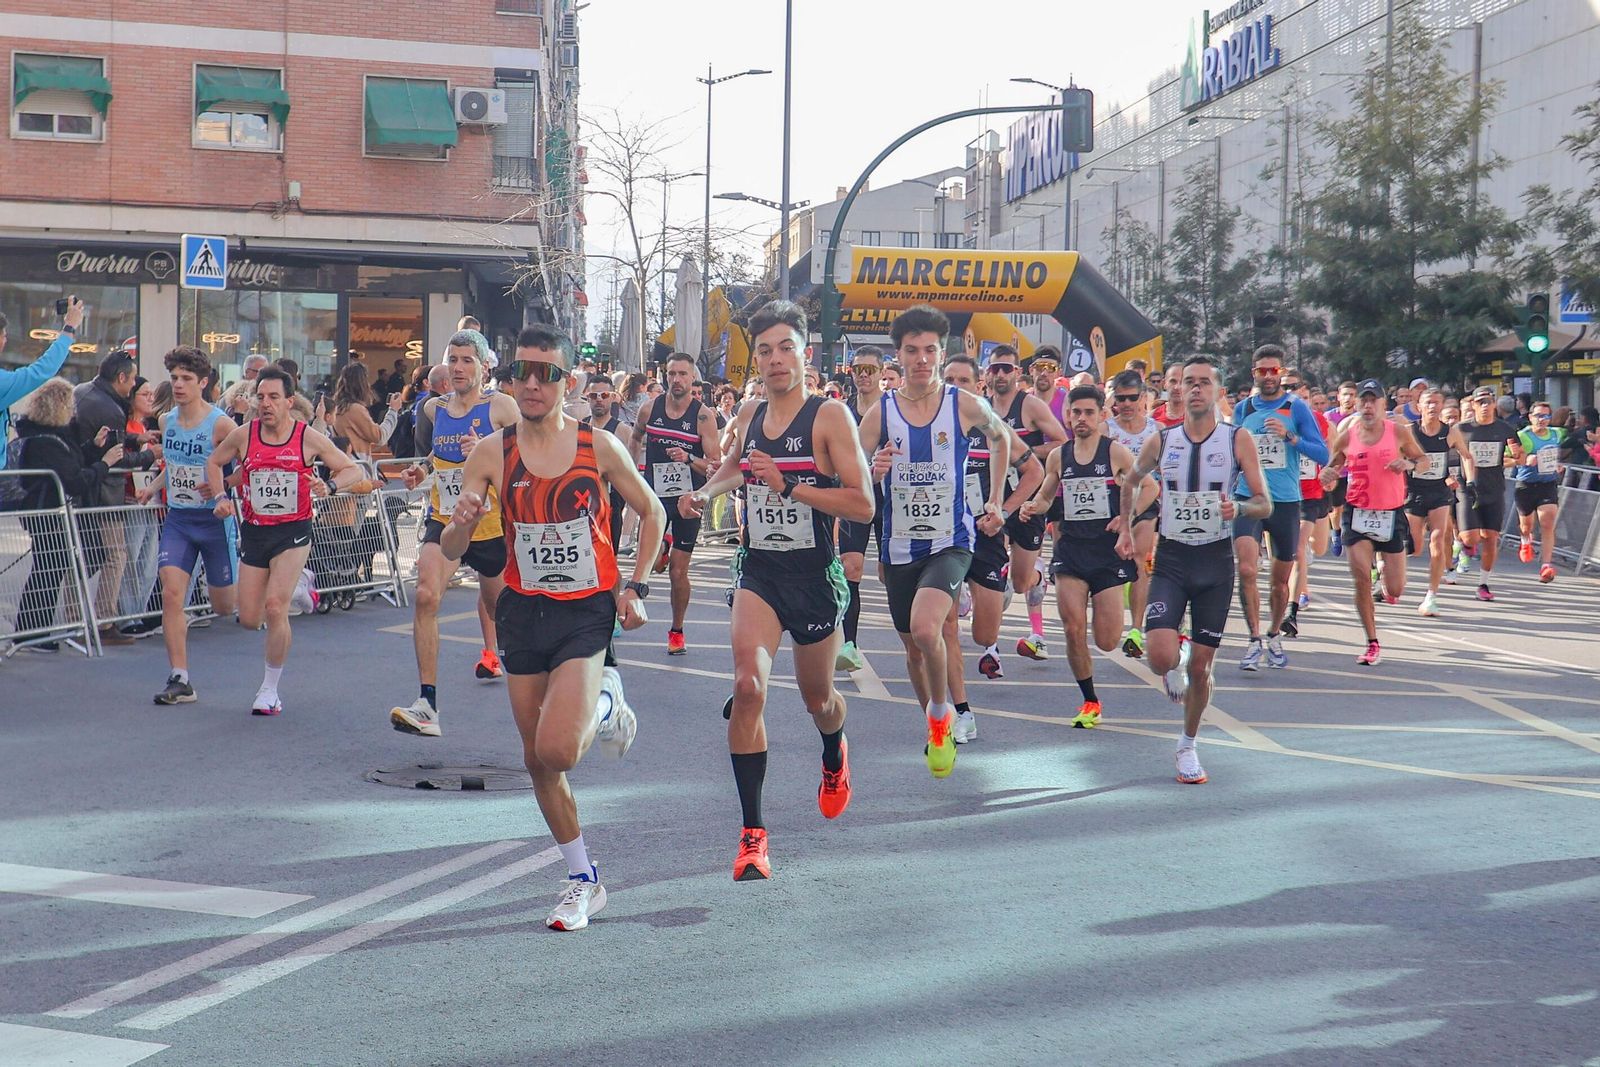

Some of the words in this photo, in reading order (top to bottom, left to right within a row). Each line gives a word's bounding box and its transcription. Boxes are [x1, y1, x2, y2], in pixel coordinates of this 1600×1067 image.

[1180, 10, 1280, 111] ARABIAL
[1006, 94, 1079, 202] HIPERCO
[57, 250, 140, 274] Puerta
[856, 256, 1047, 289] MARCELINO
[876, 289, 1025, 303] www.mpmarcelino.es
[1075, 352, 1084, 368] 1
[165, 438, 203, 456] nerja
[896, 462, 948, 472] GIPUZKOA
[171, 476, 196, 490] 2948
[662, 473, 681, 484] 242
[899, 472, 946, 482] KIROLAK
[257, 486, 288, 497] 1941
[1072, 492, 1095, 503] 764
[756, 507, 798, 524] 1515
[902, 503, 941, 517] 1832
[1175, 508, 1211, 520] 2318
[1363, 520, 1381, 529] 123
[528, 545, 579, 564] 1255
